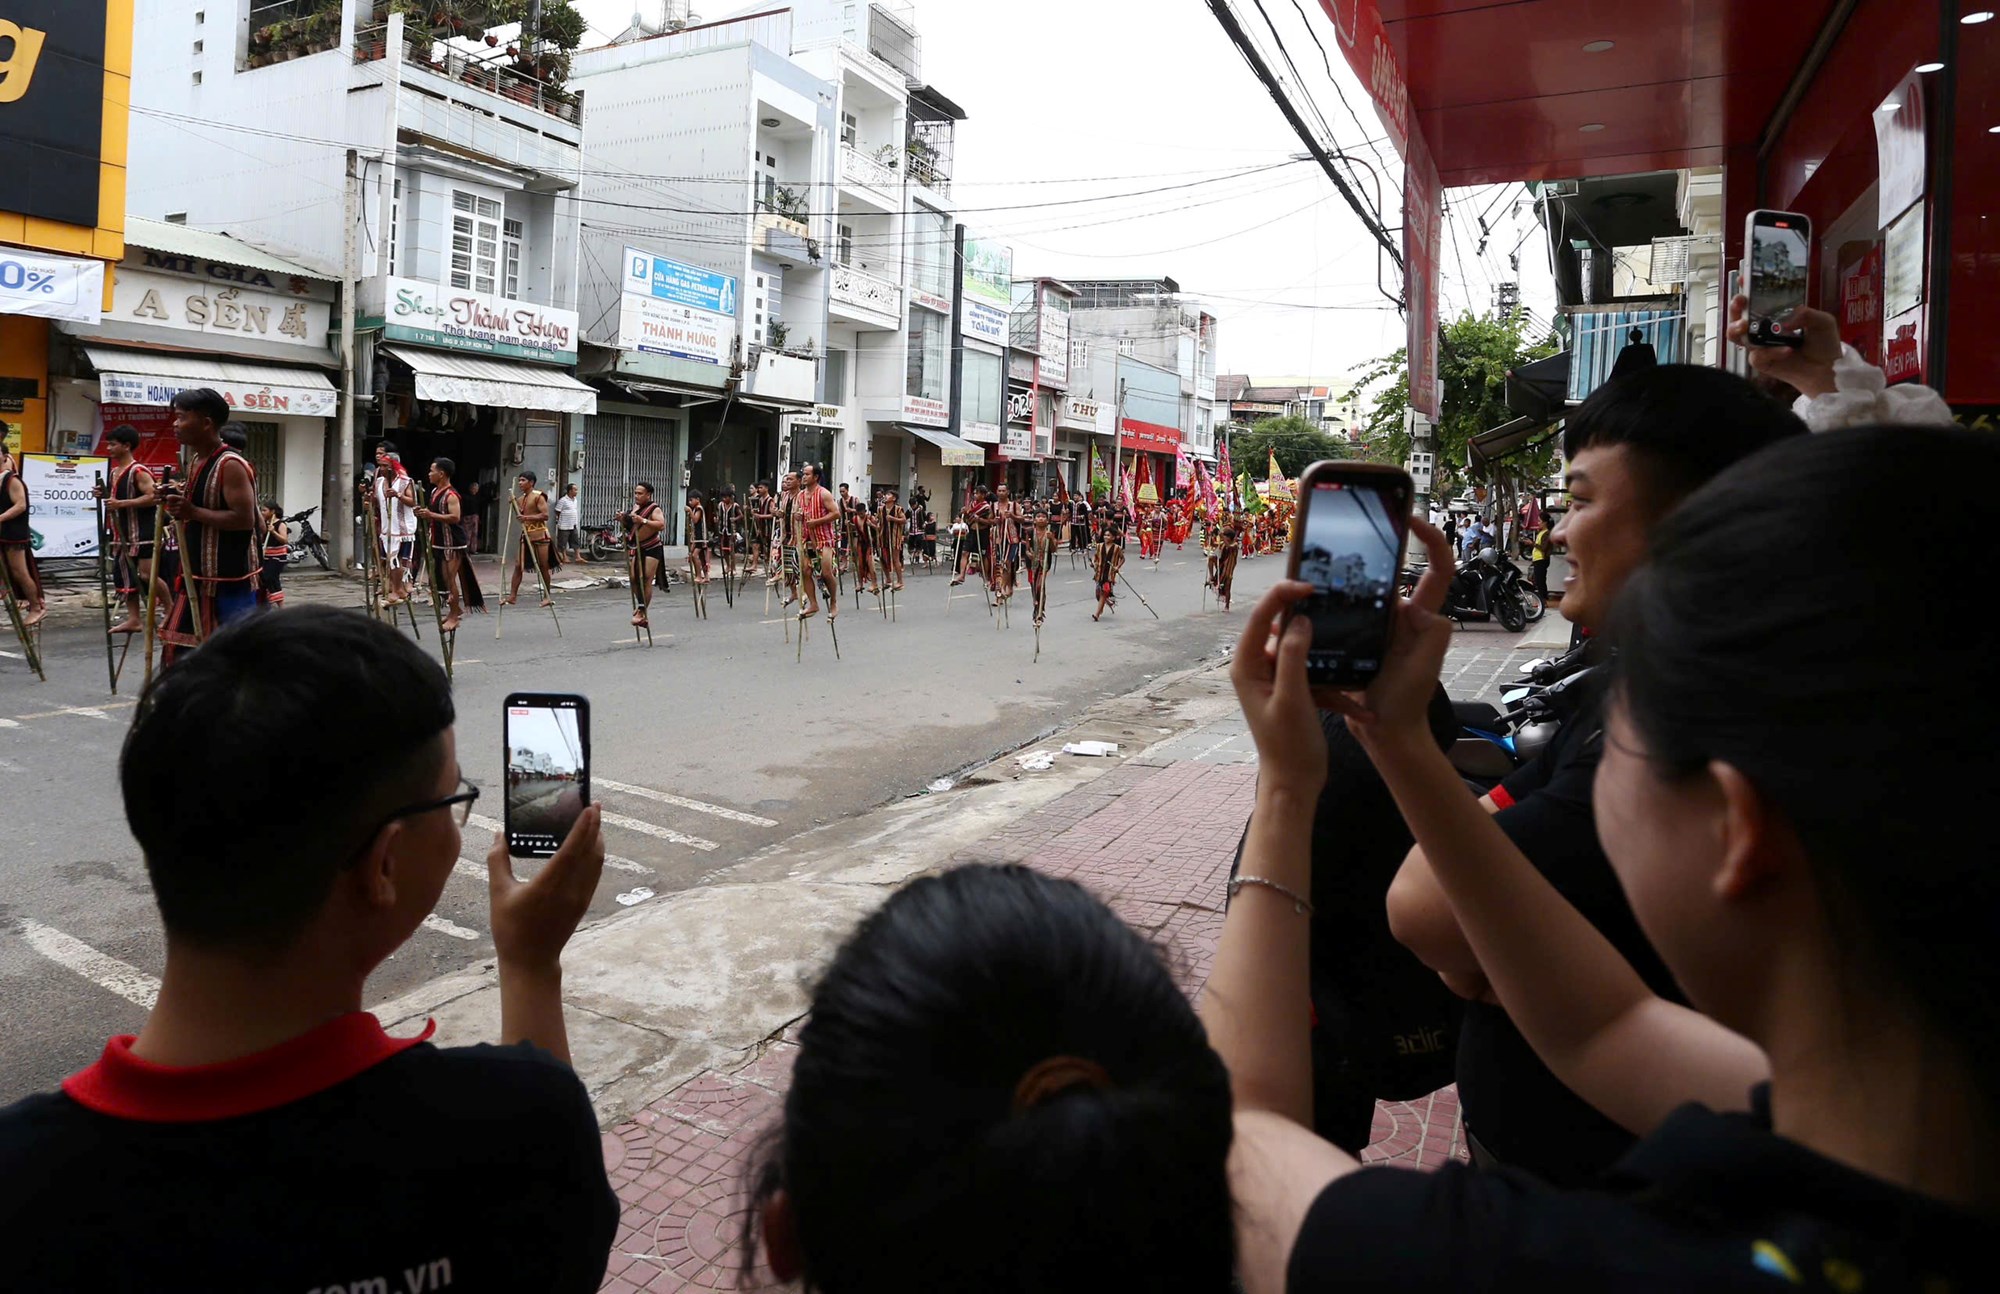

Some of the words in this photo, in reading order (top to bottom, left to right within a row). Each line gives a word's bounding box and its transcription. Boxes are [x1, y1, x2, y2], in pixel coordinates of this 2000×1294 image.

[206, 262, 275, 288] GIA
[133, 289, 169, 320] A
[394, 289, 445, 322] Shop
[450, 297, 511, 331] Thành
[470, 328, 496, 344] trang
[500, 334, 520, 344] nam
[522, 339, 539, 348] cao
[643, 321, 683, 342] THÀNH
[687, 331, 717, 348] HƯNG
[306, 1256, 452, 1294] m.vn
